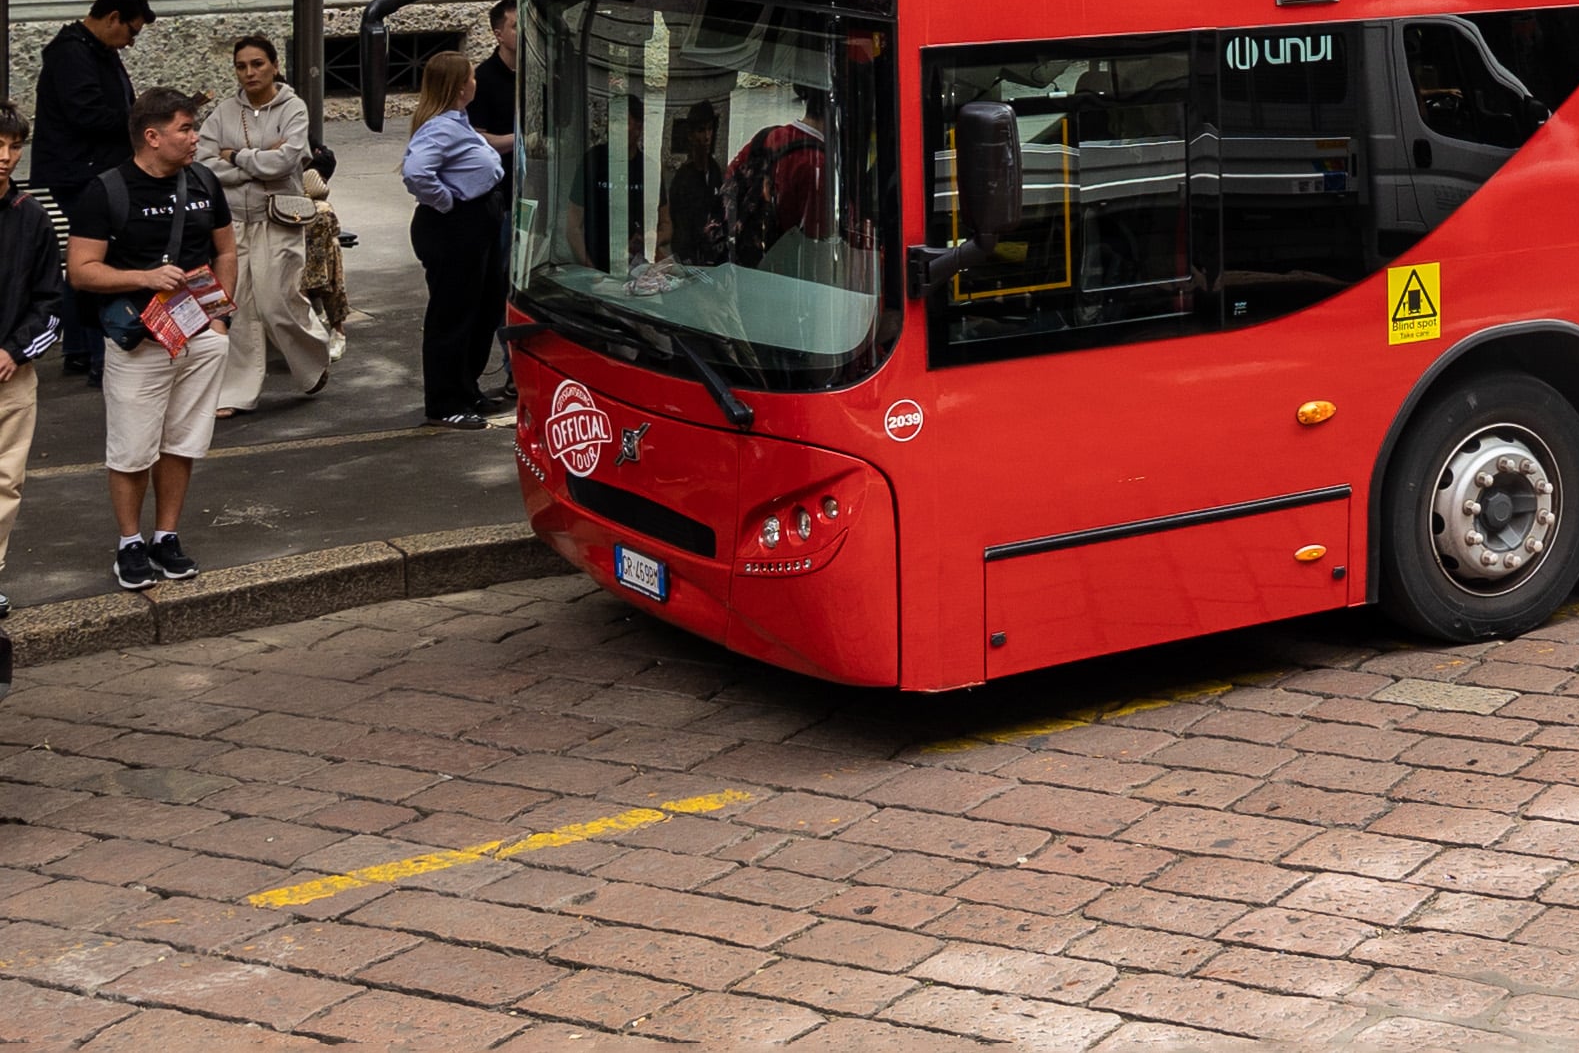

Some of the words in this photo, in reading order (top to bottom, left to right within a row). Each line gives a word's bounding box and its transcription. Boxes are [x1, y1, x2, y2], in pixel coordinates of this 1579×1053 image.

[1393, 320, 1415, 331] Blind
[1417, 318, 1437, 329] spot
[888, 412, 921, 429] 2039
[552, 415, 608, 450] OFFICIAL
[571, 446, 597, 469] TOUR
